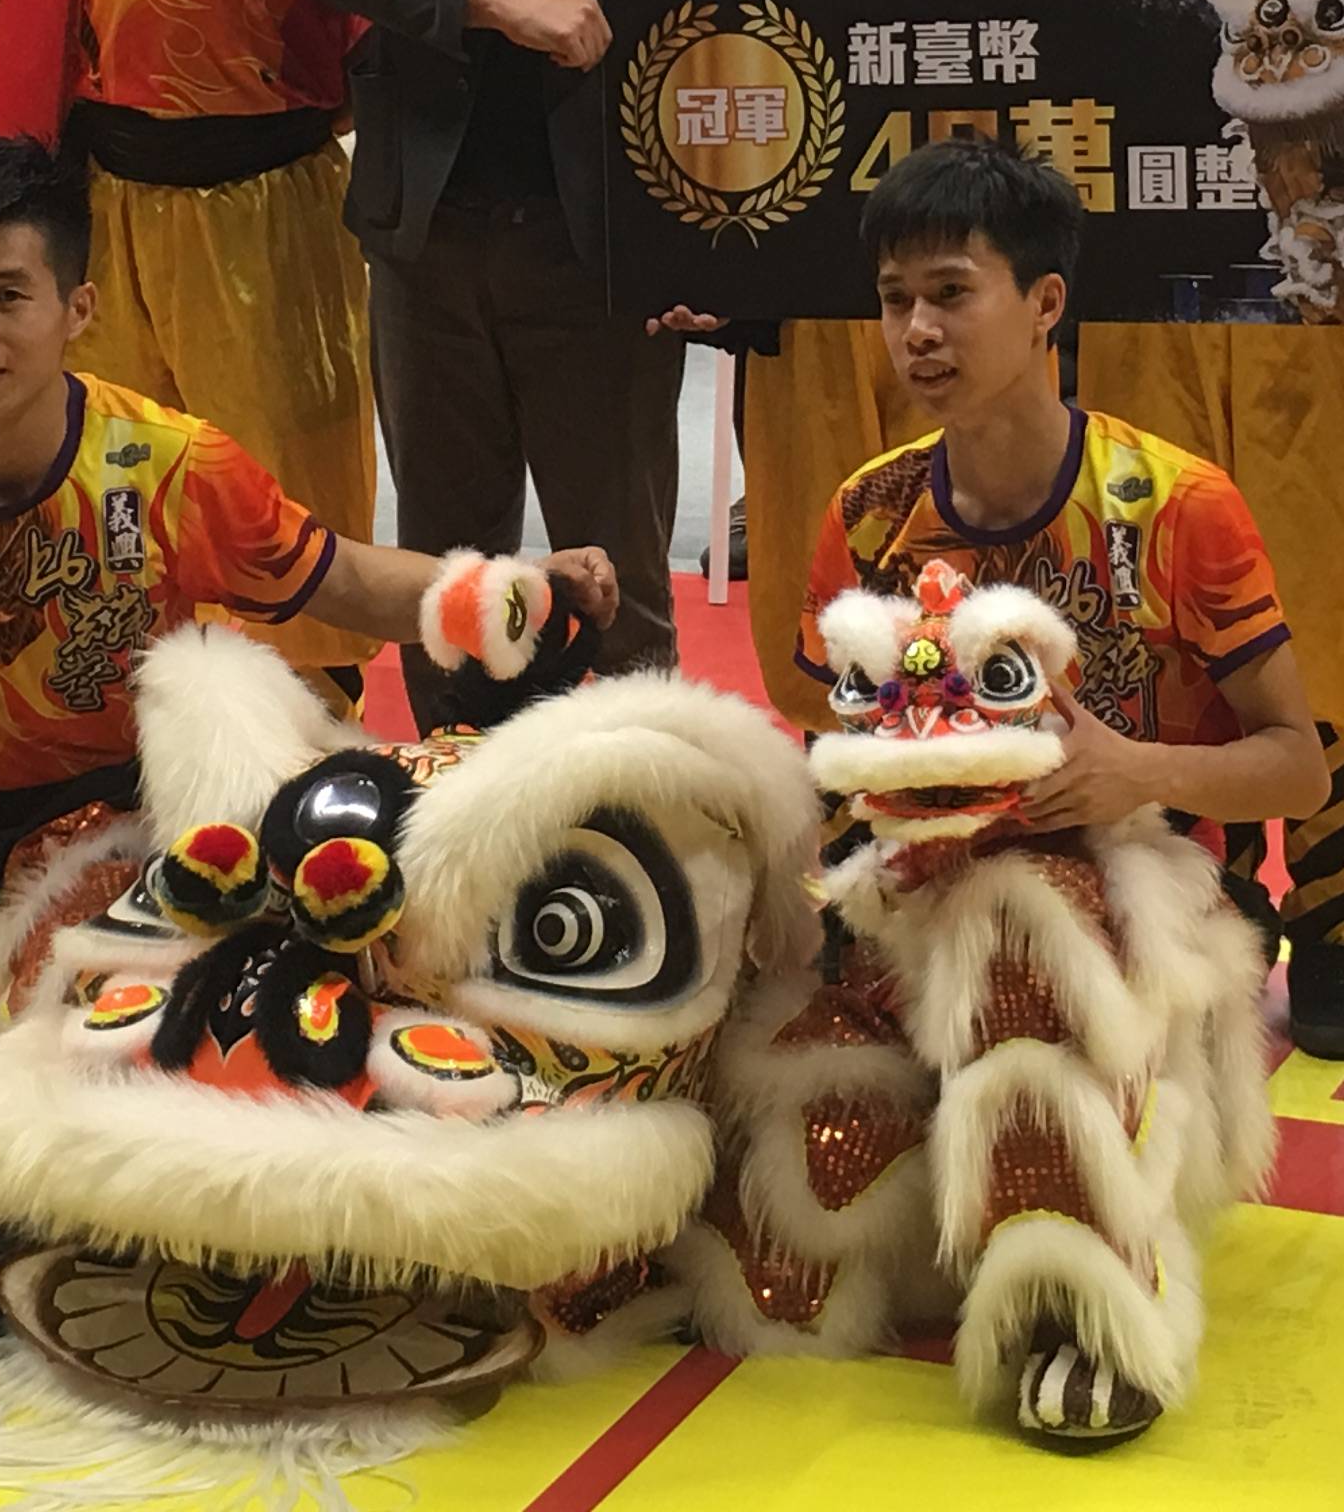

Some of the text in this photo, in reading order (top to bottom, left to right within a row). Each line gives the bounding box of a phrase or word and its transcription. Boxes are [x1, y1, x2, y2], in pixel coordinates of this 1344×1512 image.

[847, 18, 1040, 86] 新臺幣
[675, 85, 789, 146] 冠軍
